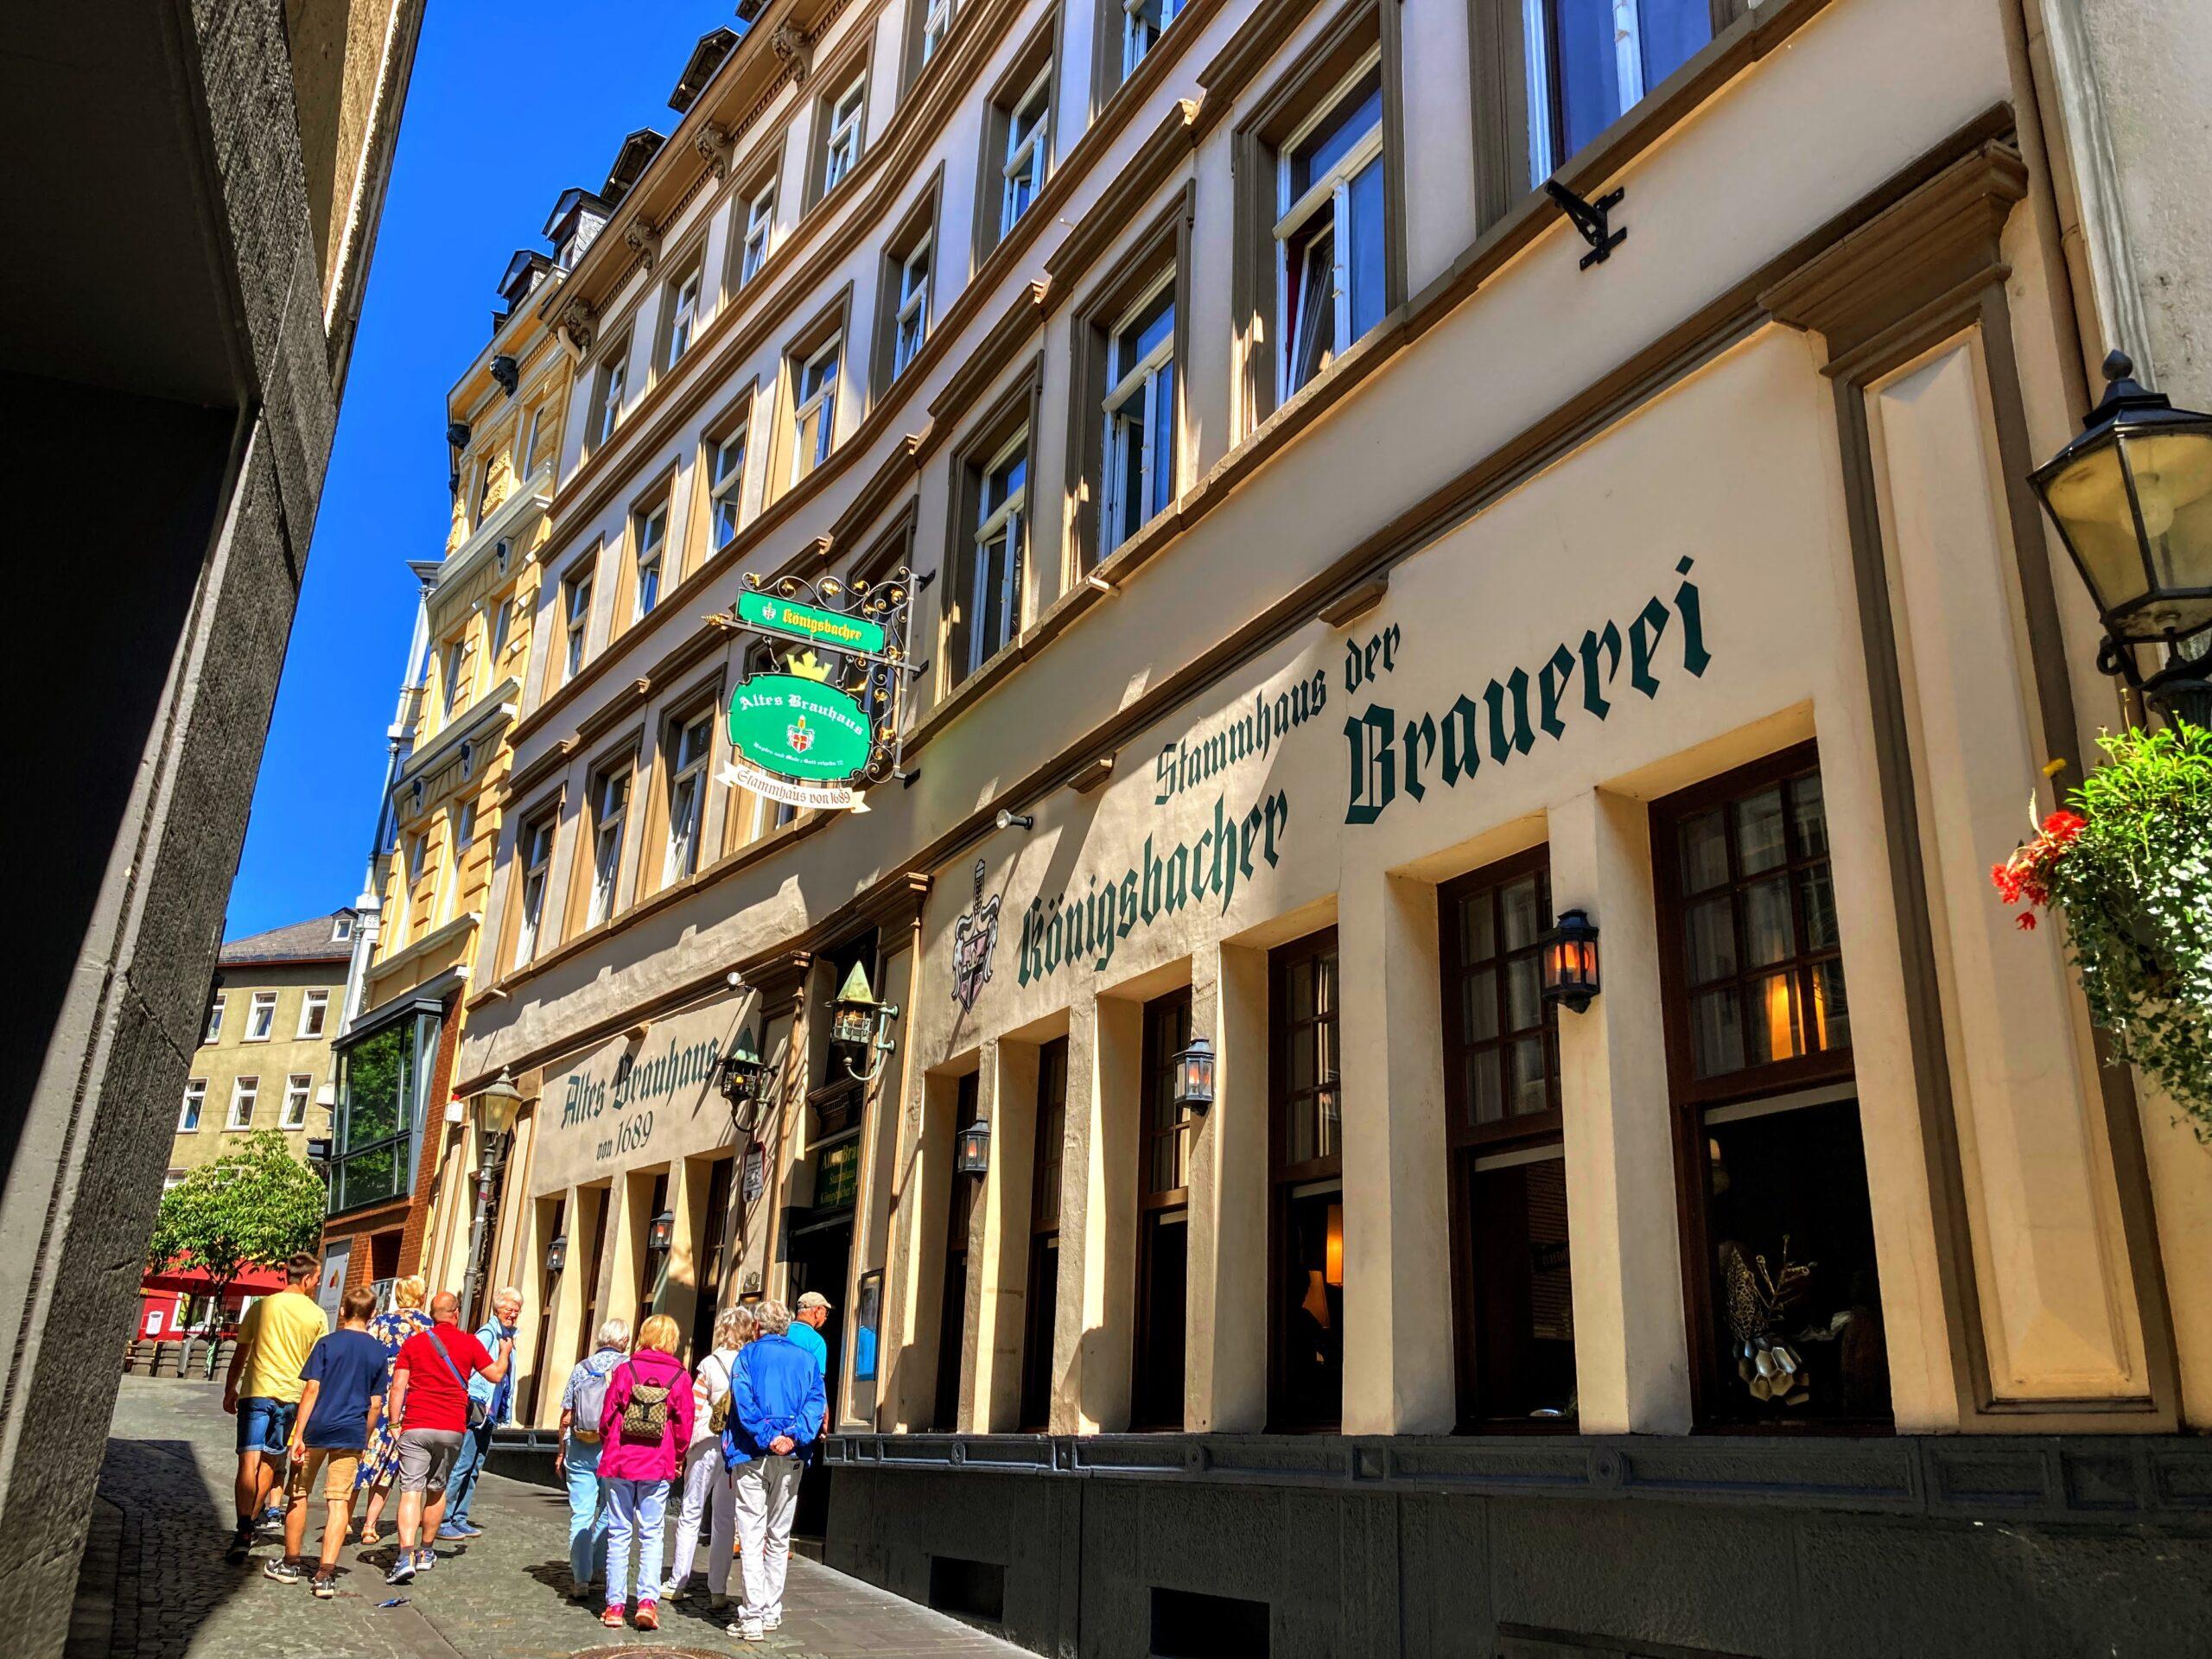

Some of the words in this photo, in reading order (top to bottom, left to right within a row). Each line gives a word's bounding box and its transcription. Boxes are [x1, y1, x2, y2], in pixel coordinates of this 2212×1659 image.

[783, 608, 862, 641] Königsbacher
[740, 694, 784, 711] Altes
[788, 693, 863, 736] Brauhaus
[1155, 667, 1326, 805] Stammhaus
[1345, 621, 1401, 693] der
[737, 770, 806, 802] Stammhaus
[810, 792, 829, 804] von
[830, 791, 851, 805] 1689
[1018, 788, 1287, 988] Königsbacher
[1344, 554, 1712, 825] Brauerei
[561, 1071, 606, 1130] Altes
[613, 1035, 720, 1110] Brauhaus
[596, 1137, 613, 1161] von
[615, 1110, 653, 1156] 1689
